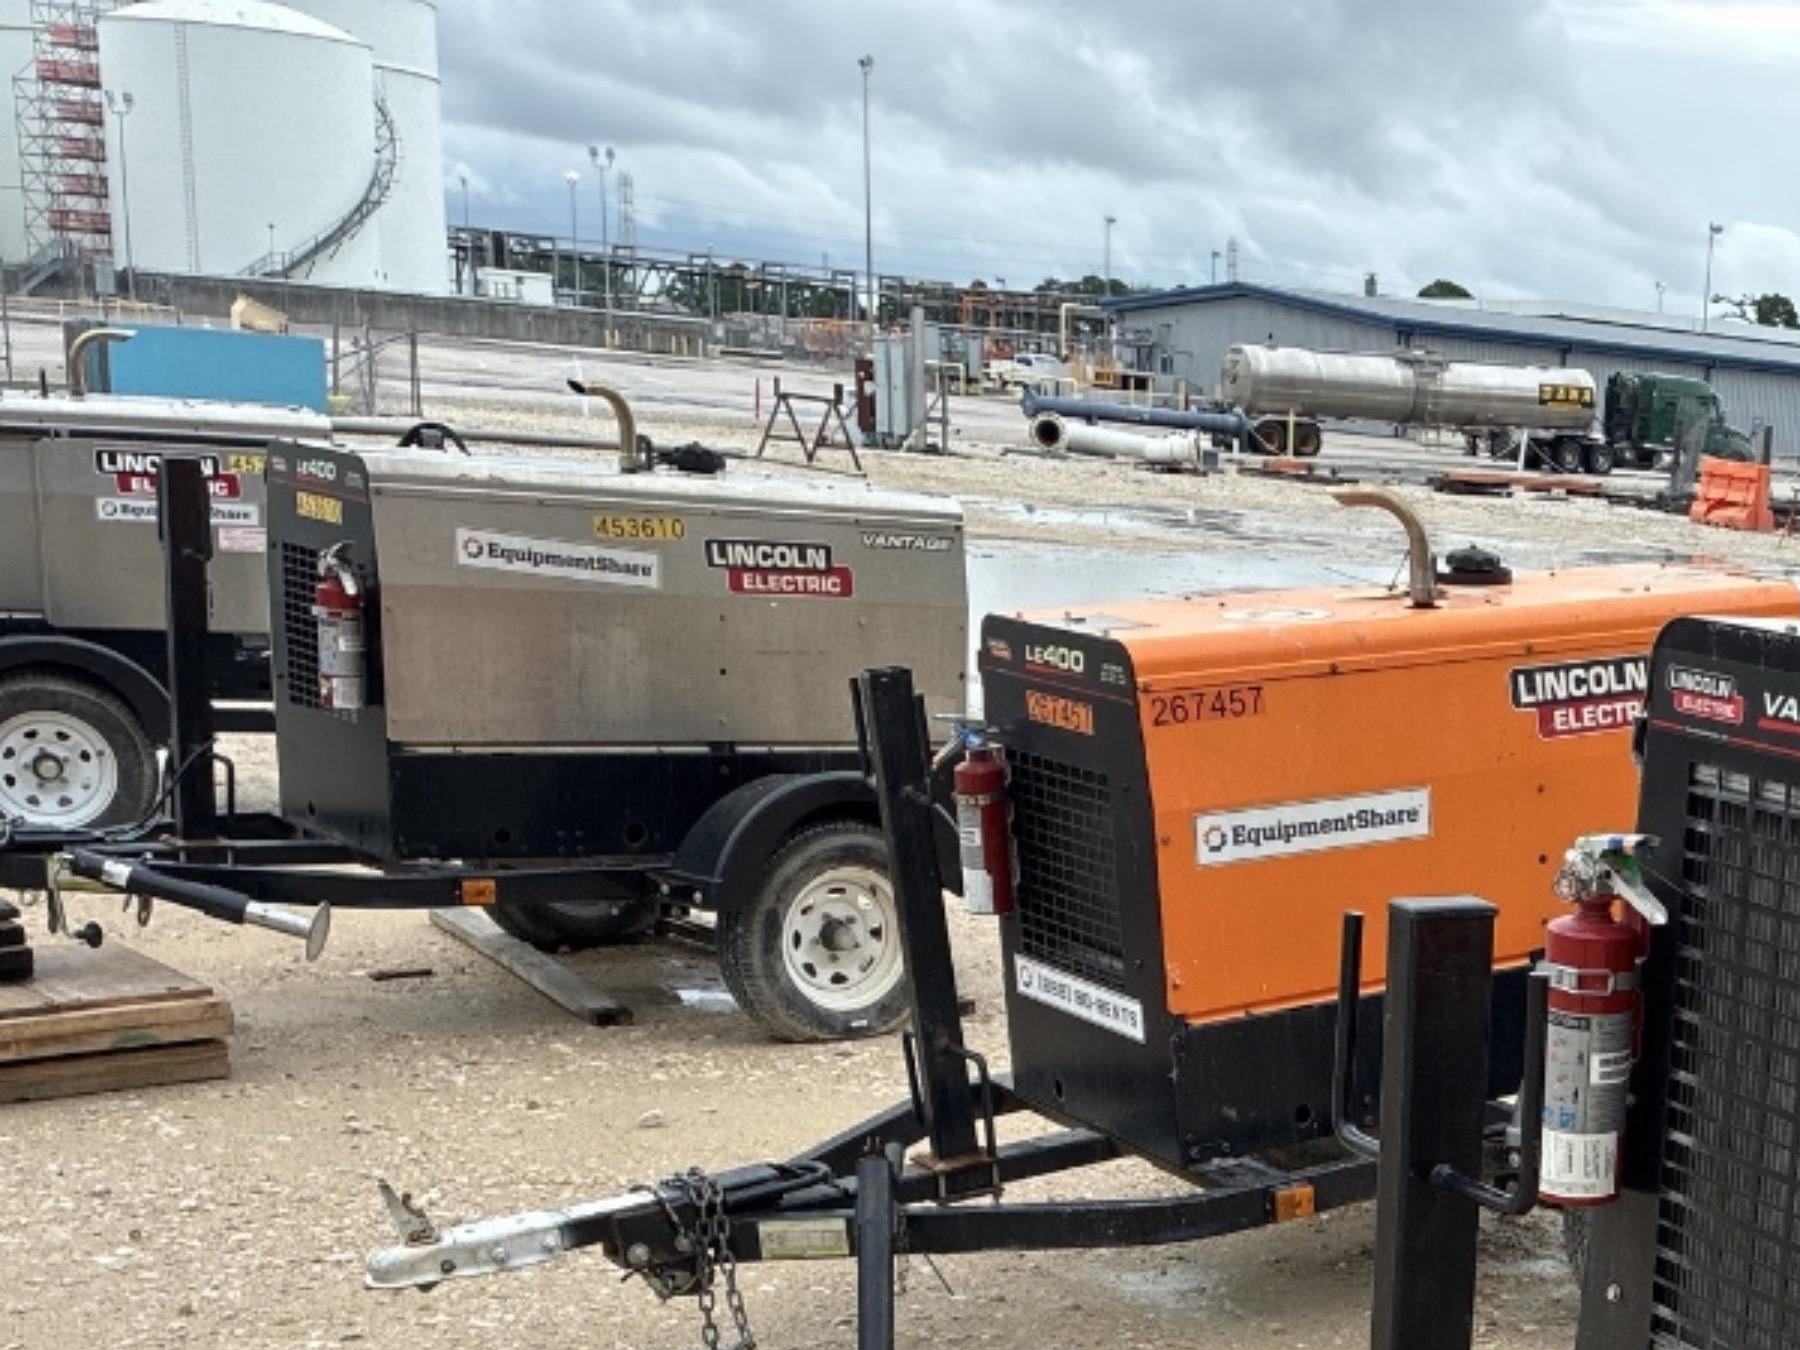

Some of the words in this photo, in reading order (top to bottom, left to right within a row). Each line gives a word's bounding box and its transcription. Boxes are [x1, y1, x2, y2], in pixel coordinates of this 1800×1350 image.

[101, 452, 214, 477] LINCN
[595, 517, 686, 540] 453610
[862, 532, 953, 551] VANTAGE
[487, 541, 653, 577] EquipmentShare
[710, 542, 826, 571] LINCOLN
[742, 572, 842, 593] ELECTRIC
[1025, 644, 1085, 673] LE400
[1517, 660, 1648, 703] LINCOLN
[1151, 686, 1263, 727] 267457
[1553, 701, 1648, 731] ELECTR
[1231, 804, 1420, 847] EquipmentShare
